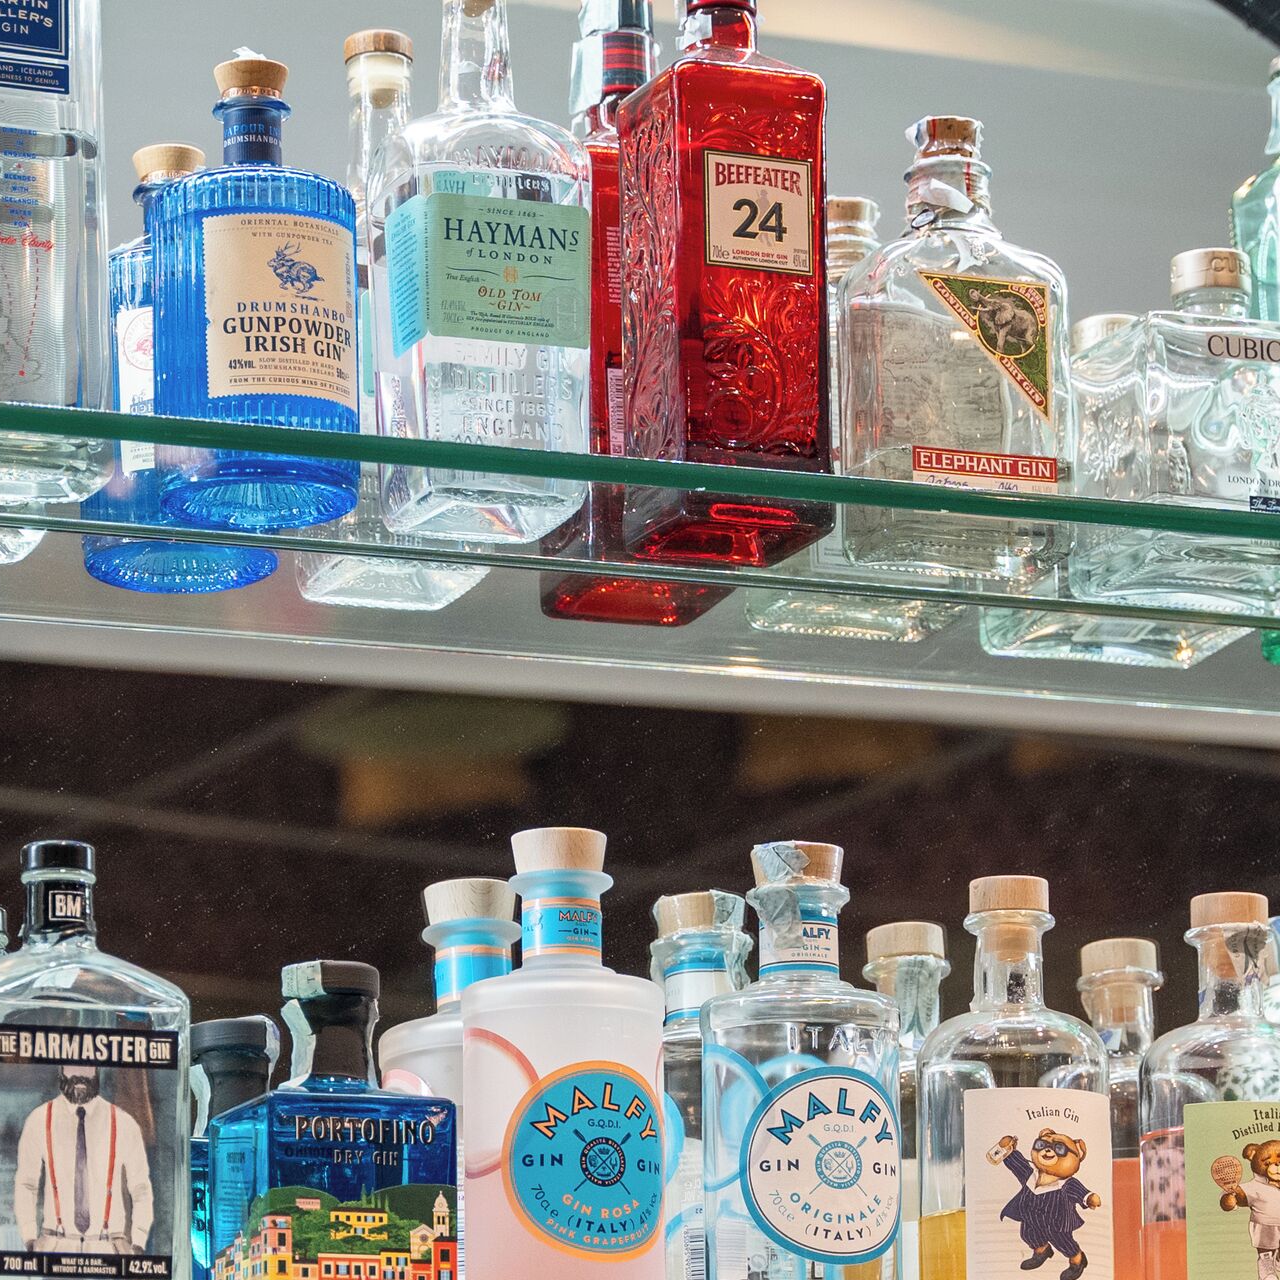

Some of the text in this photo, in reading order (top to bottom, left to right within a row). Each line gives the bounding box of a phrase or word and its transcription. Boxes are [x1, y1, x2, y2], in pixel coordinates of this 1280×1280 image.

[2, 22, 28, 34] GIN
[21, 67, 53, 76] ICELAND
[715, 161, 802, 196] BEEFEATER
[240, 218, 339, 237] ORIENTAL BOTANICALS
[733, 199, 787, 242] 24
[276, 233, 319, 242] GUNPOWDER
[478, 250, 552, 265] LONDON
[478, 286, 541, 301] OLD TOM
[237, 302, 345, 323] DRUMSHANBO
[934, 280, 977, 329] LONDON
[223, 316, 351, 348] GUNPOWDER
[245, 336, 341, 362] IRISH GIN
[1001, 358, 1045, 405] DRY GIN
[920, 453, 1052, 477] ELEPHANT GIN
[54, 894, 81, 916] BM
[573, 927, 590, 935] GIN
[20, 1031, 147, 1063] BARMASTER
[150, 1042, 170, 1060] GIN
[530, 1082, 657, 1140] MALFY
[767, 1088, 893, 1144] MALFY
[1026, 1107, 1080, 1123] Italian Gin
[293, 1115, 436, 1146] PORTOFINO
[1232, 1122, 1274, 1140] Distilled
[334, 1149, 399, 1166] DRY GIN
[522, 1154, 563, 1167] GIN
[637, 1159, 660, 1175] GIN
[759, 1159, 799, 1172] GIN
[873, 1162, 896, 1177] GIN
[562, 1194, 640, 1218] GIN ROSA
[790, 1192, 882, 1224] ORIGINALE
[584, 1224, 649, 1245] GRAPEFRUIT
[3, 1257, 38, 1270] 700 ml
